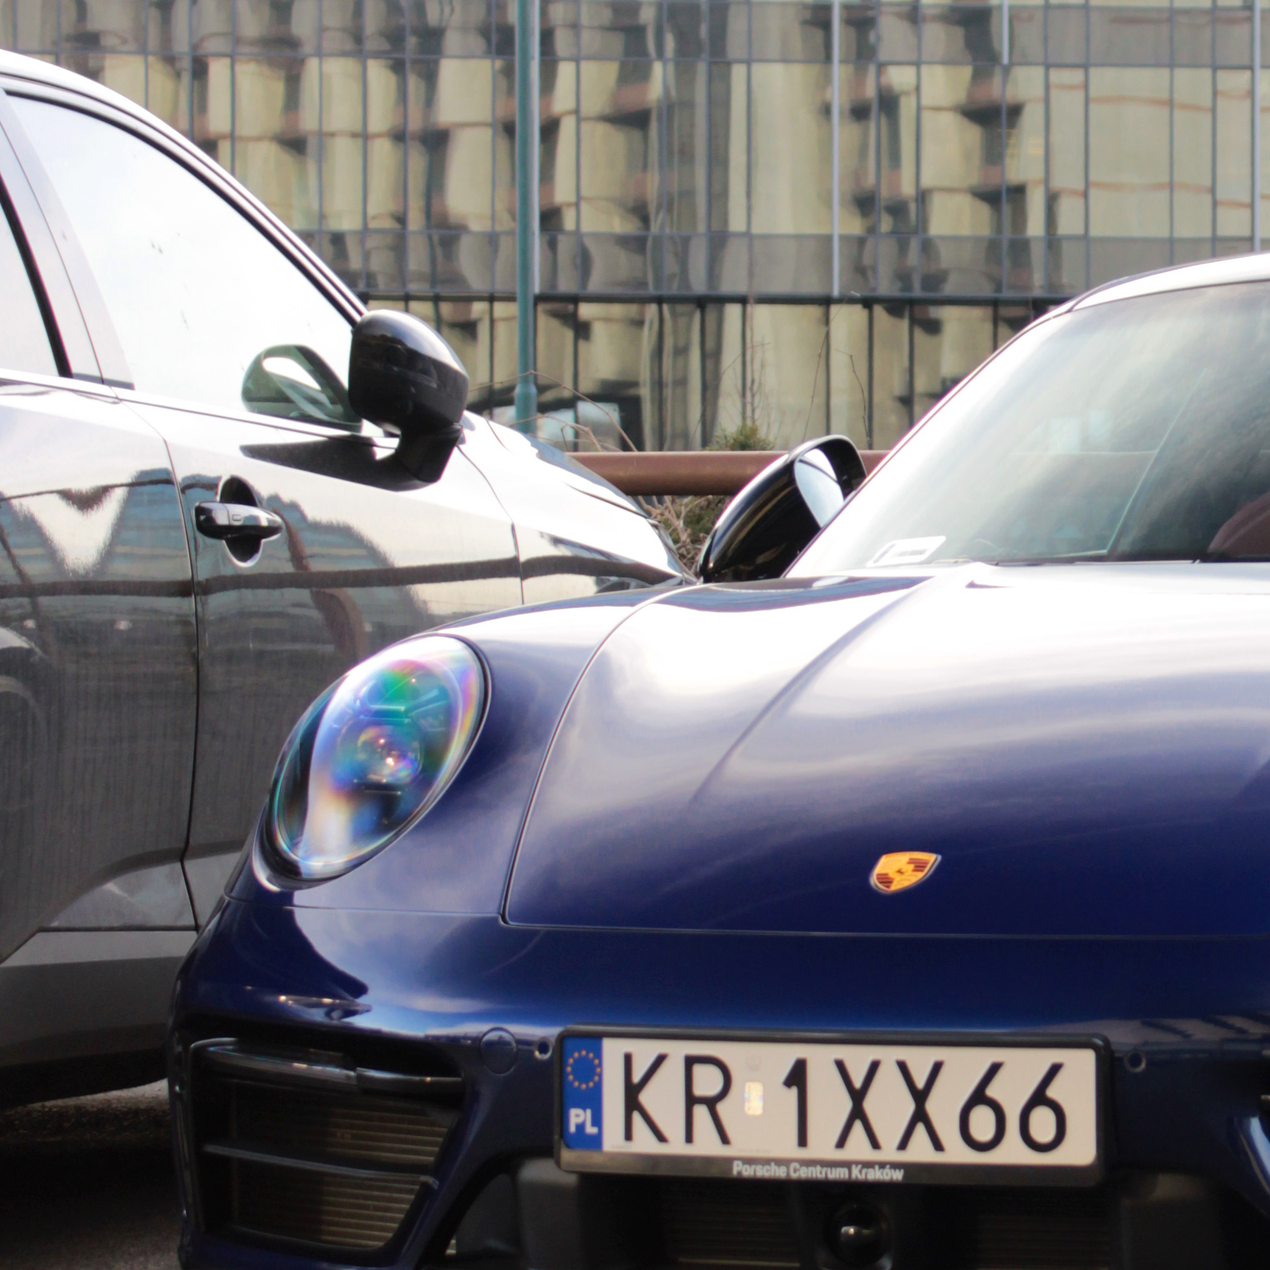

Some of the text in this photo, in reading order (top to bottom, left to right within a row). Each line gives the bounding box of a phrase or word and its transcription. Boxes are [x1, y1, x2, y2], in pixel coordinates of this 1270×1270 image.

[623, 1052, 1068, 1154] KR 1XX66
[569, 1107, 599, 1135] PL
[732, 1160, 904, 1181] Porsche Centrum Kraków
